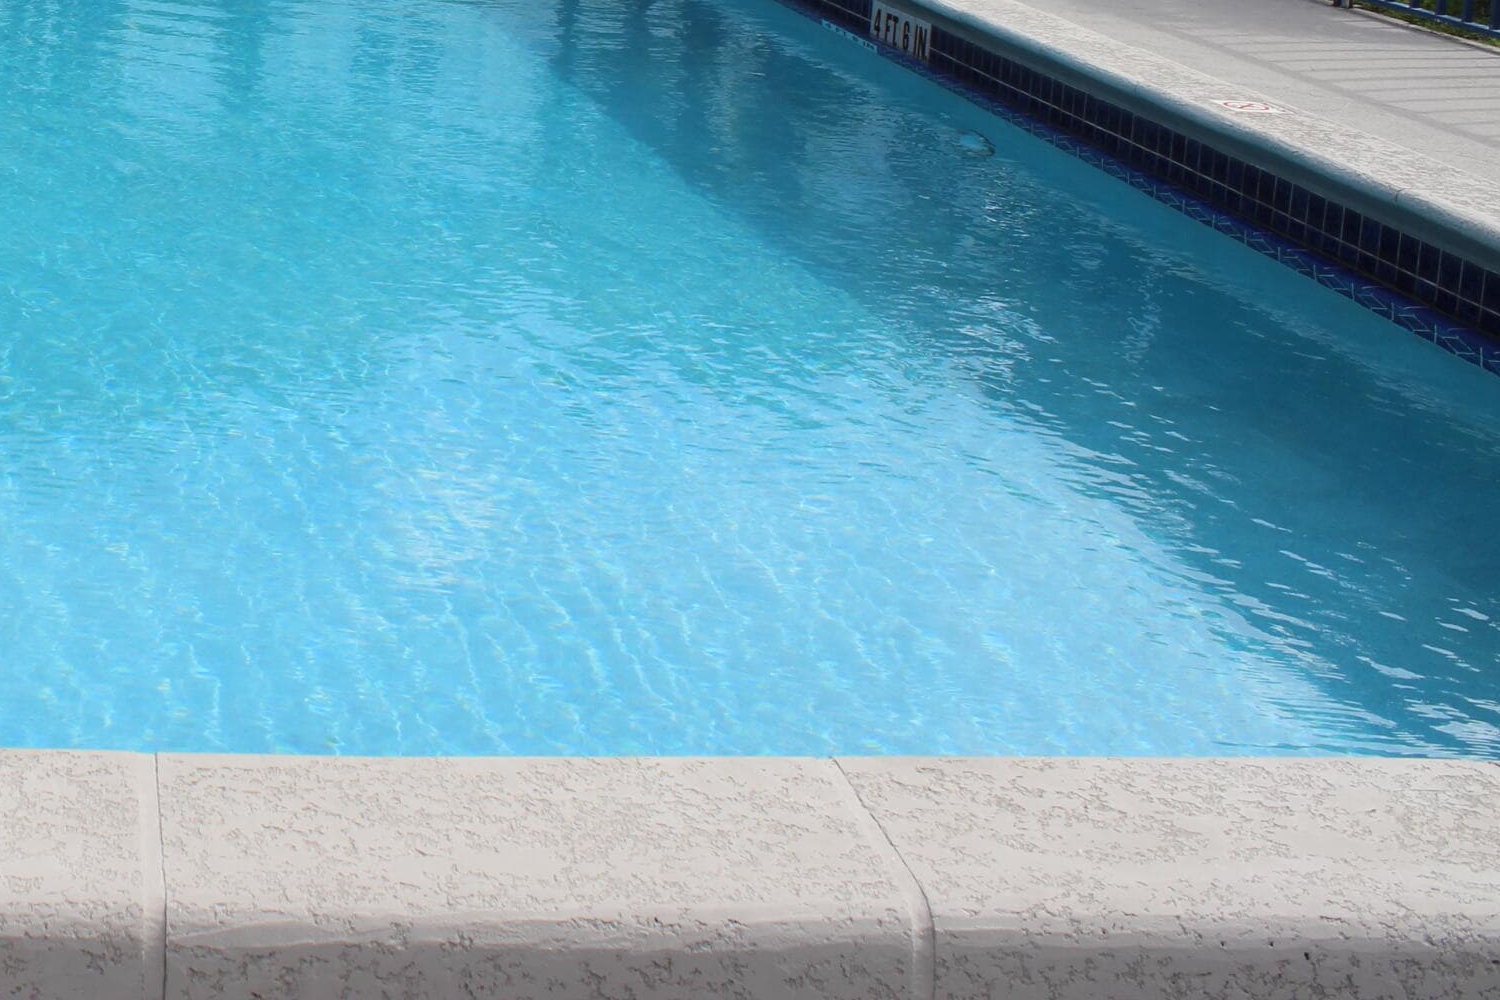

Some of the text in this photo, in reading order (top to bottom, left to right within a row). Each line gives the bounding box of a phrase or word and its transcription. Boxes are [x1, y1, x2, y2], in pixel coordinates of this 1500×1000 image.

[874, 8, 928, 60] 4 FT 6 IN
